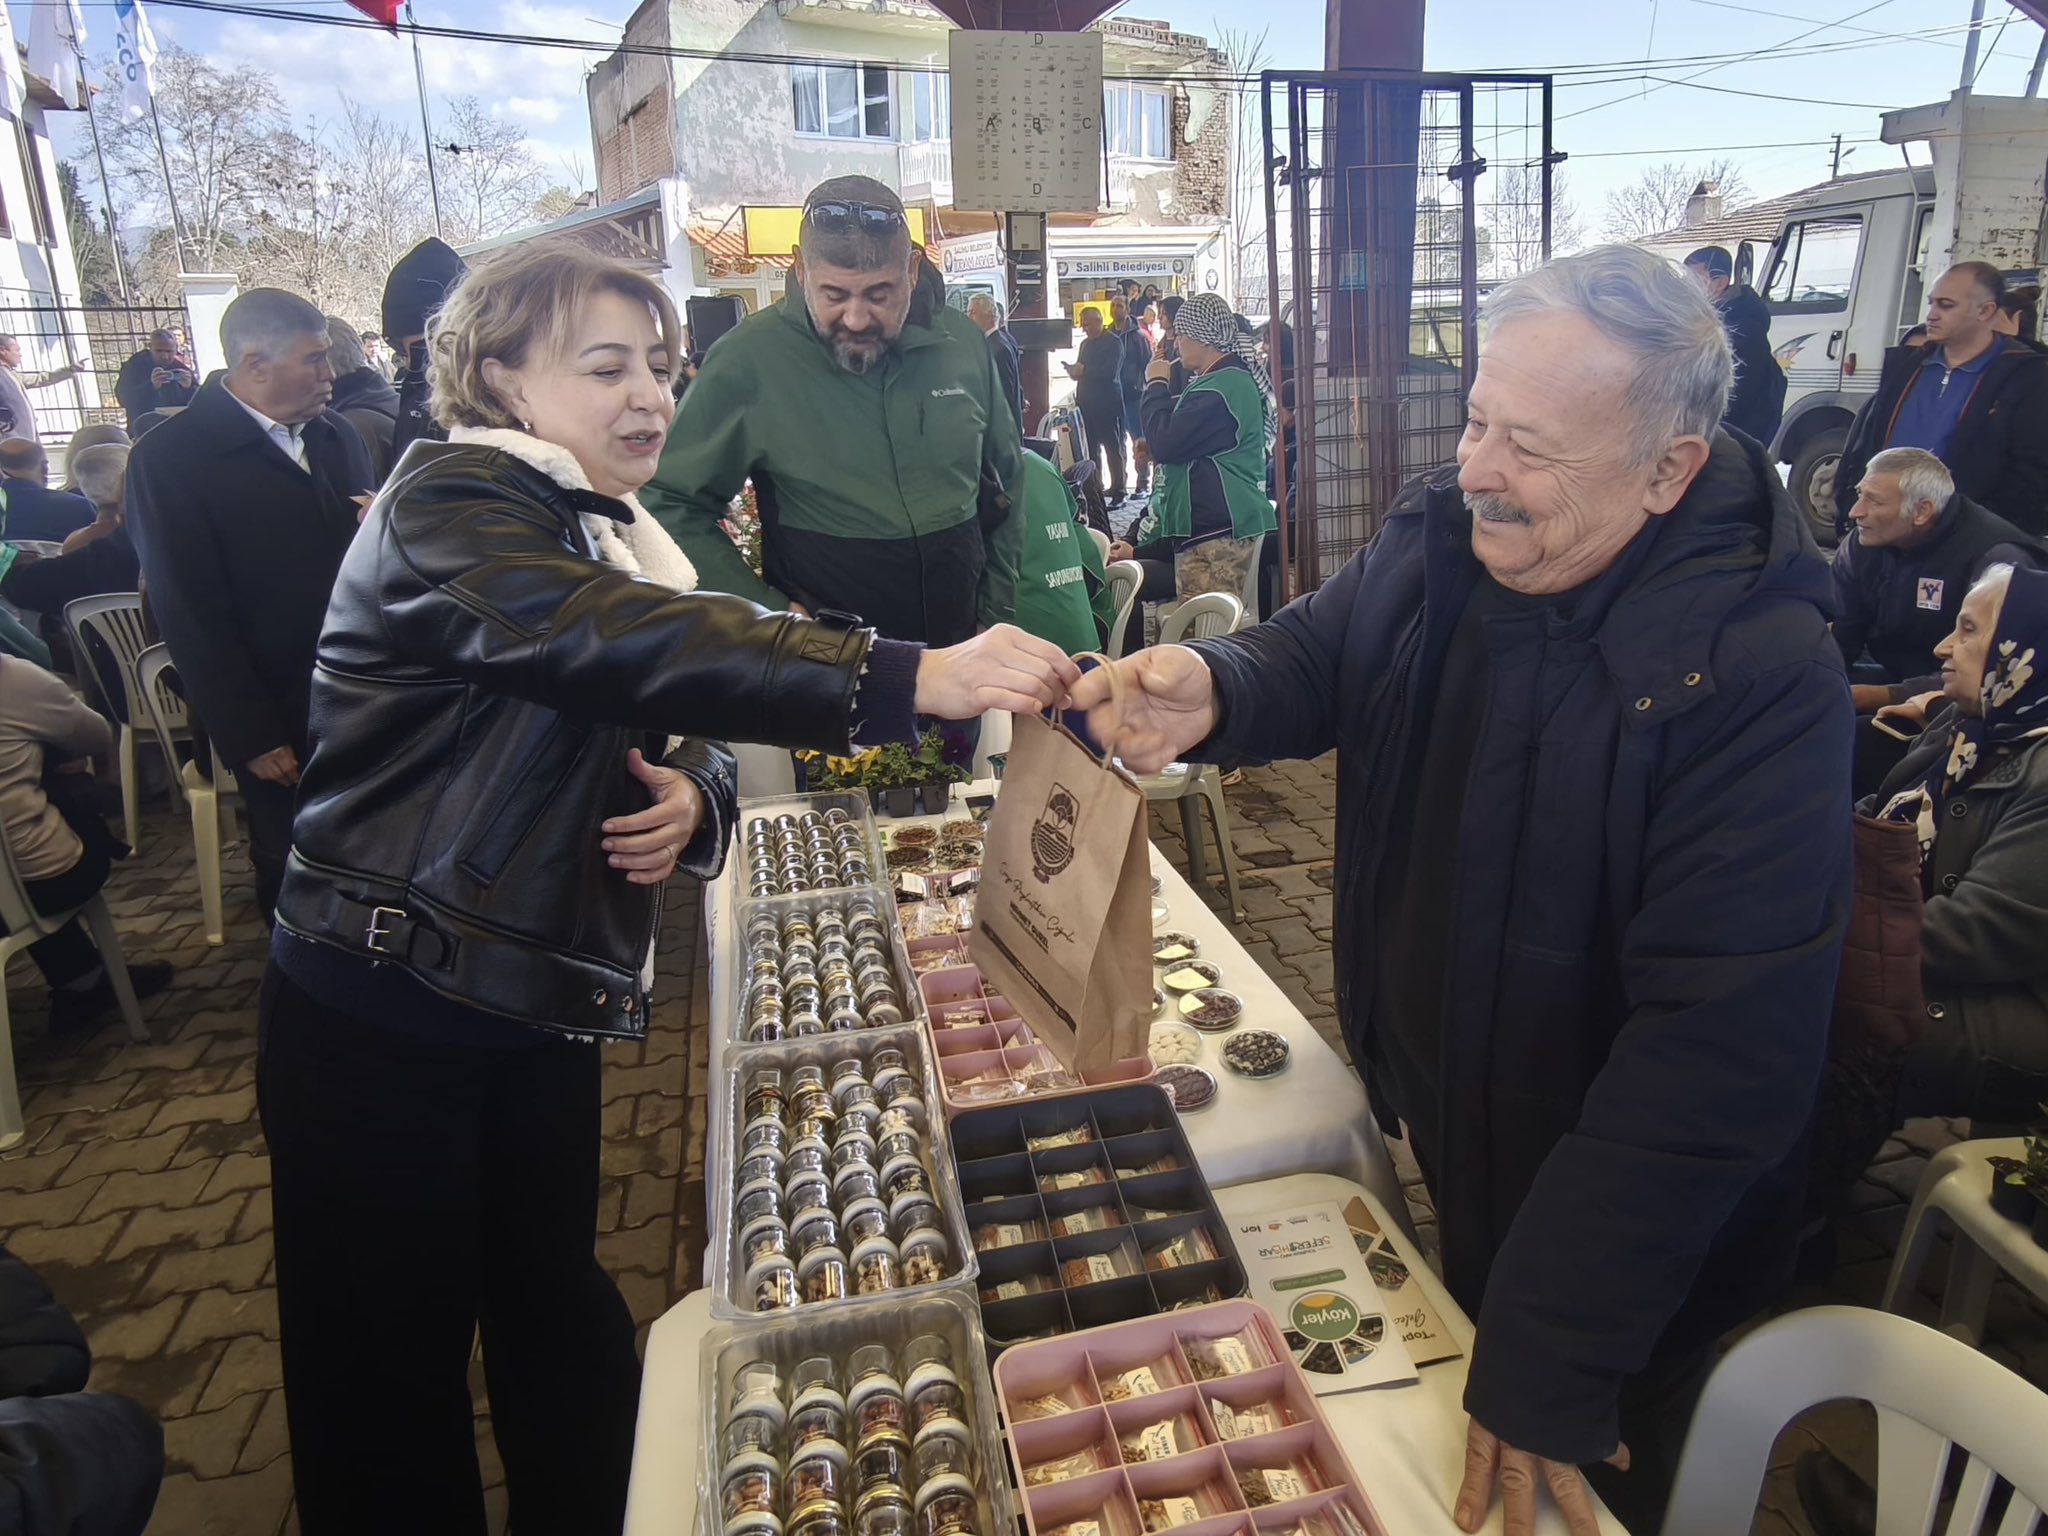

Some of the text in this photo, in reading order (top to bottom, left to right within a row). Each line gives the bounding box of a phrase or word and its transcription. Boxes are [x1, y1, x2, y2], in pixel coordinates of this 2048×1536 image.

[1034, 33, 1044, 45] D
[1082, 118, 1091, 129] C
[1033, 183, 1042, 195] D
[1076, 261, 1167, 273] Salihli Belediyesi
[1301, 1306, 1352, 1326] Köyler
